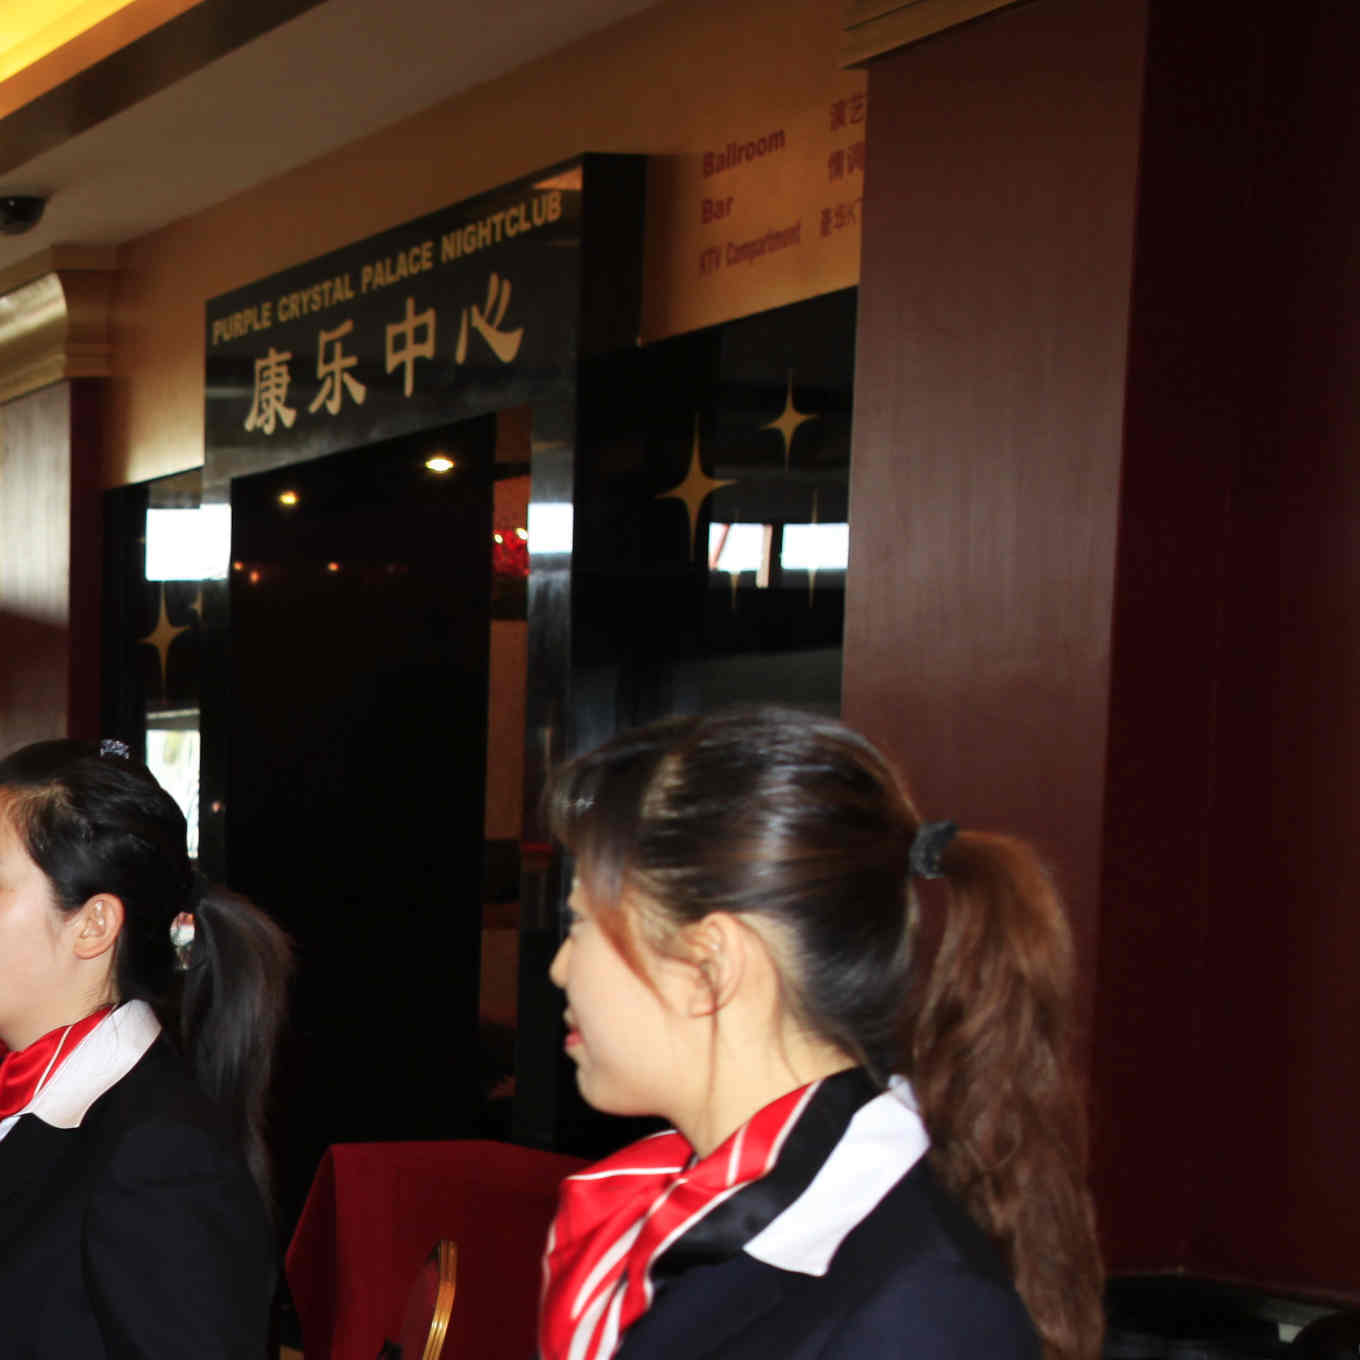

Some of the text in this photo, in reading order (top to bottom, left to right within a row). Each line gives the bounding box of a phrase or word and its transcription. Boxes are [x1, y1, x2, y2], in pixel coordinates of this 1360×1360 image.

[703, 129, 785, 180] Ballroom
[701, 196, 734, 225] Bar
[212, 190, 563, 346] PURPLE CRYSTAL PALACE NIGHTCLUB
[244, 272, 525, 436] 康乐中心
